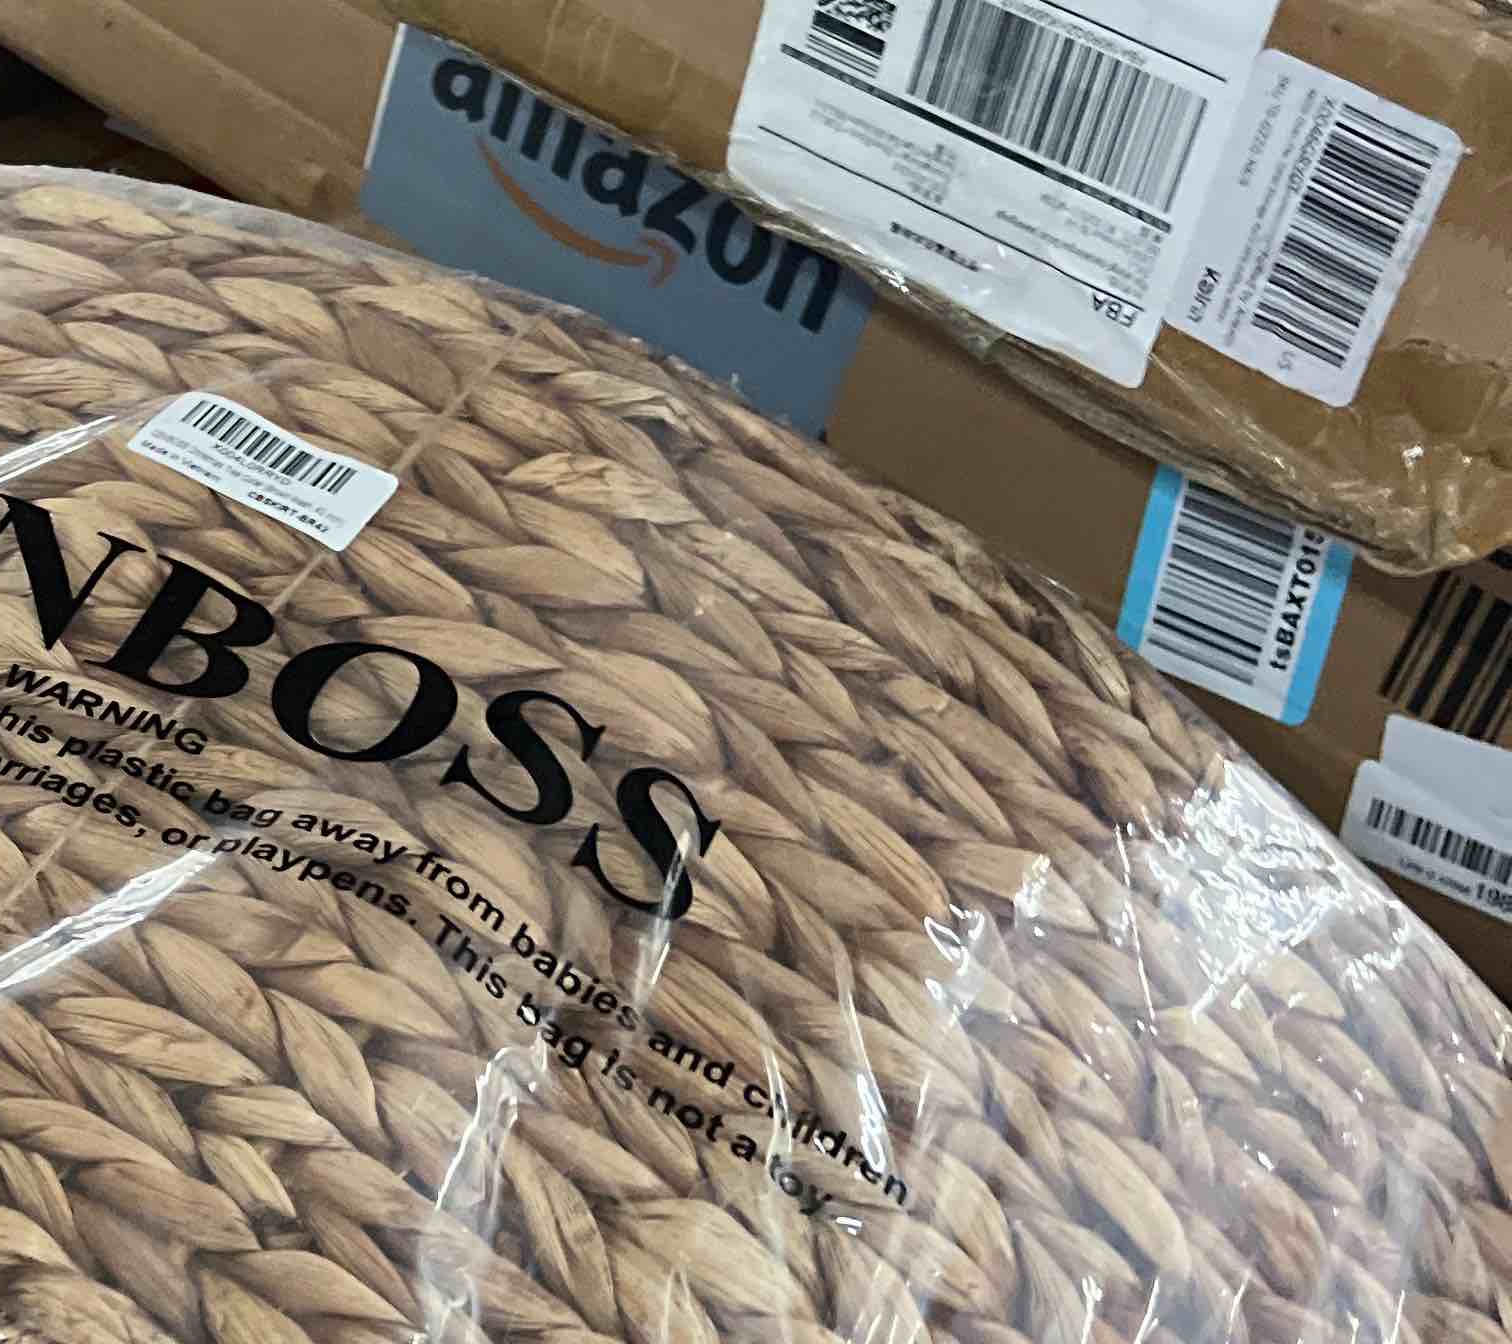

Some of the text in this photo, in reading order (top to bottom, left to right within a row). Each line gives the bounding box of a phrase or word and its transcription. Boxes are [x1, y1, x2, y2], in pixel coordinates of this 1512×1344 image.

[432, 57, 842, 335] amazon
[1091, 291, 1137, 329] FBA
[4, 663, 209, 755] WARNING
[56, 735, 196, 803] plastic
[203, 787, 284, 829] bag
[291, 812, 408, 865] away
[415, 851, 505, 932] from
[510, 922, 640, 1032] babies
[647, 1029, 735, 1090] and
[160, 826, 211, 852] or
[212, 833, 418, 925] playpens.
[434, 913, 508, 1000] This
[516, 991, 591, 1069] bag
[600, 1048, 637, 1092] is
[647, 1084, 725, 1144] not
[730, 1131, 758, 1163] a
